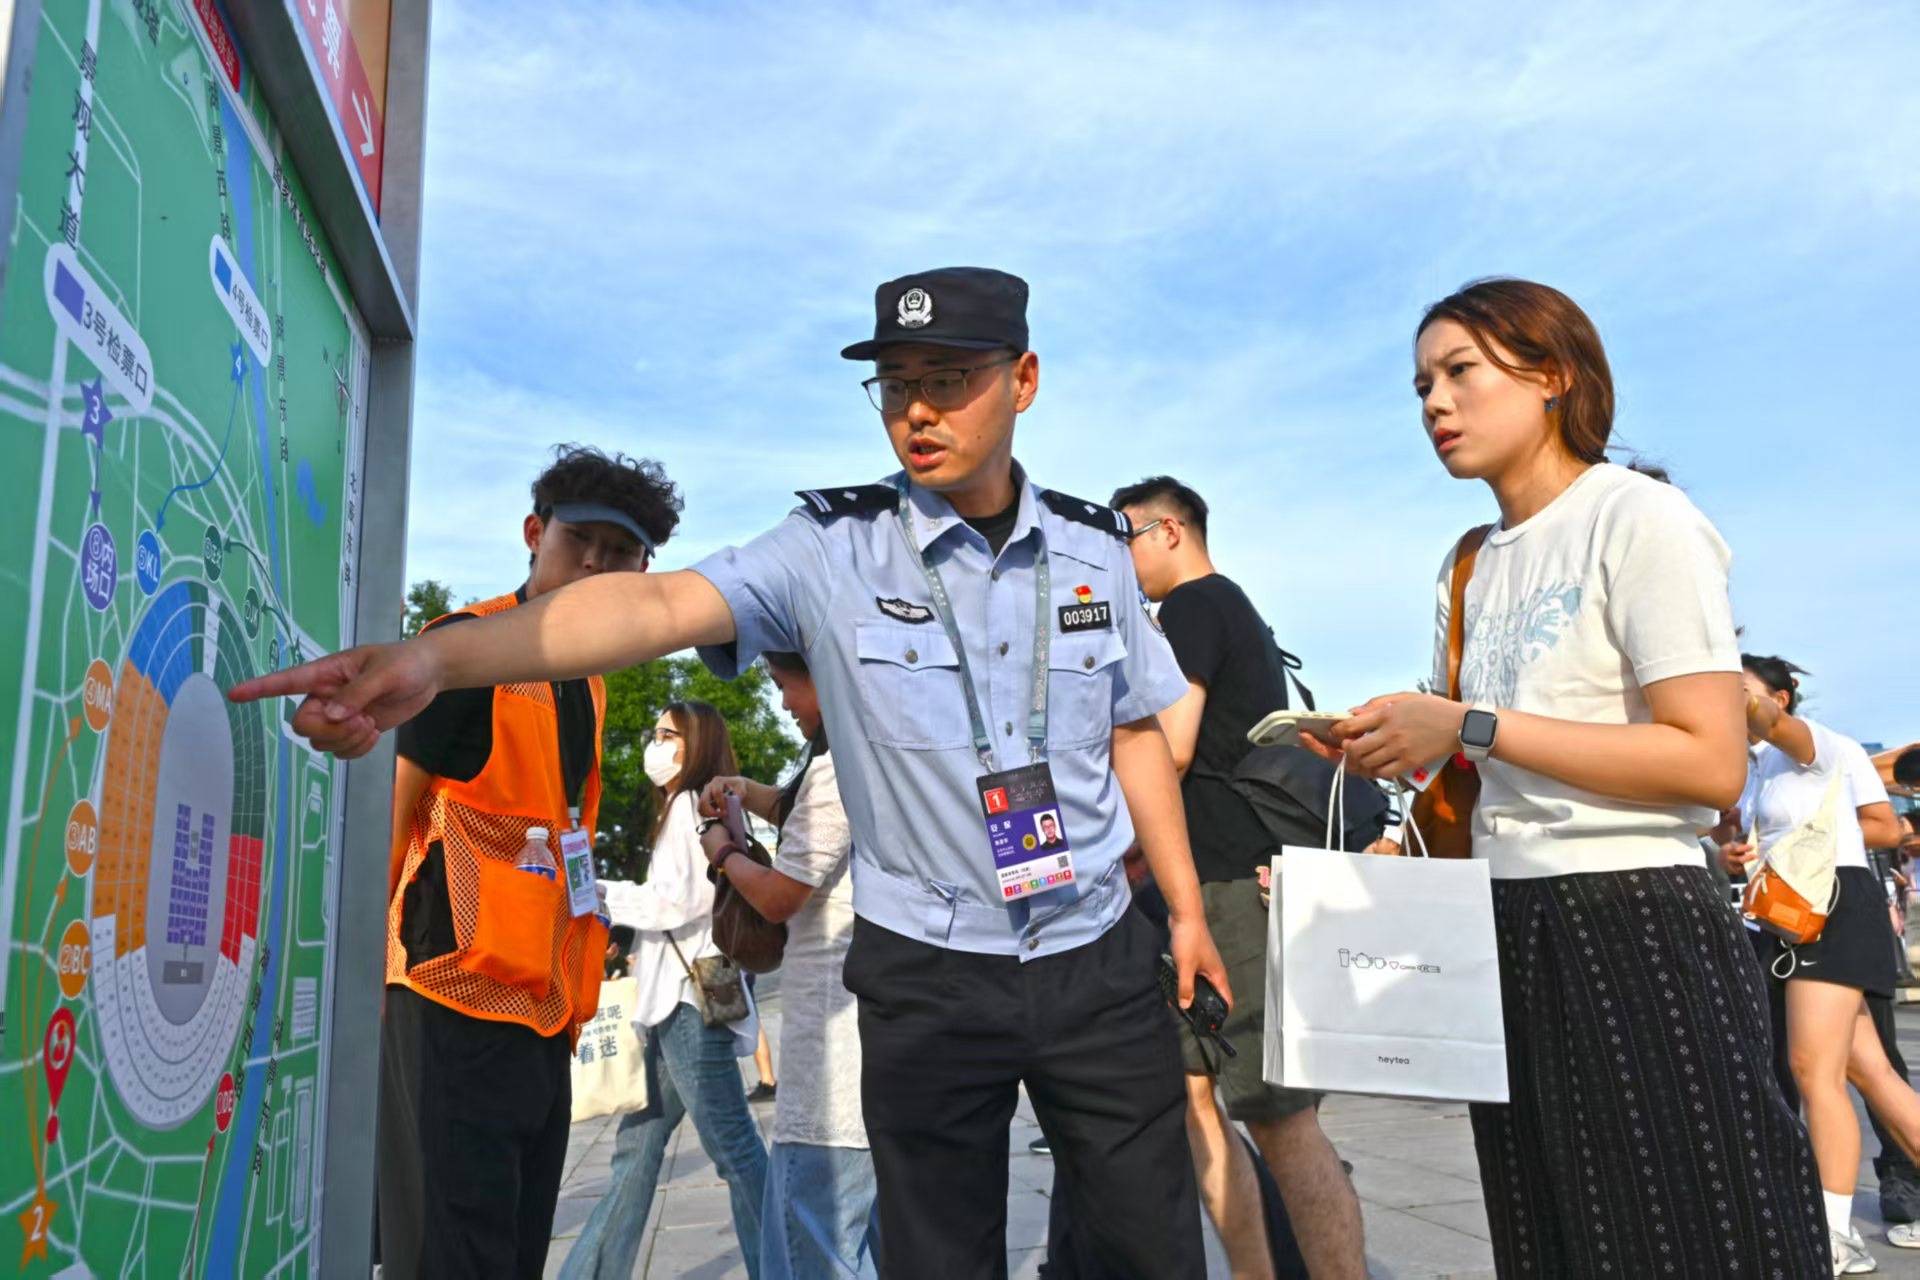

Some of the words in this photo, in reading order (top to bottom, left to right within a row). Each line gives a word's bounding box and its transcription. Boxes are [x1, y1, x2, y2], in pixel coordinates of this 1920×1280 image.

[58, 39, 97, 250] 景观大道
[231, 284, 269, 351] 4号检票口
[82, 301, 148, 397] 3号检票口
[235, 355, 242, 377] 4
[89, 396, 100, 425] 3
[1063, 606, 1108, 626] 003917
[1378, 1055, 1409, 1064] heytea
[31, 1205, 44, 1242] 2
